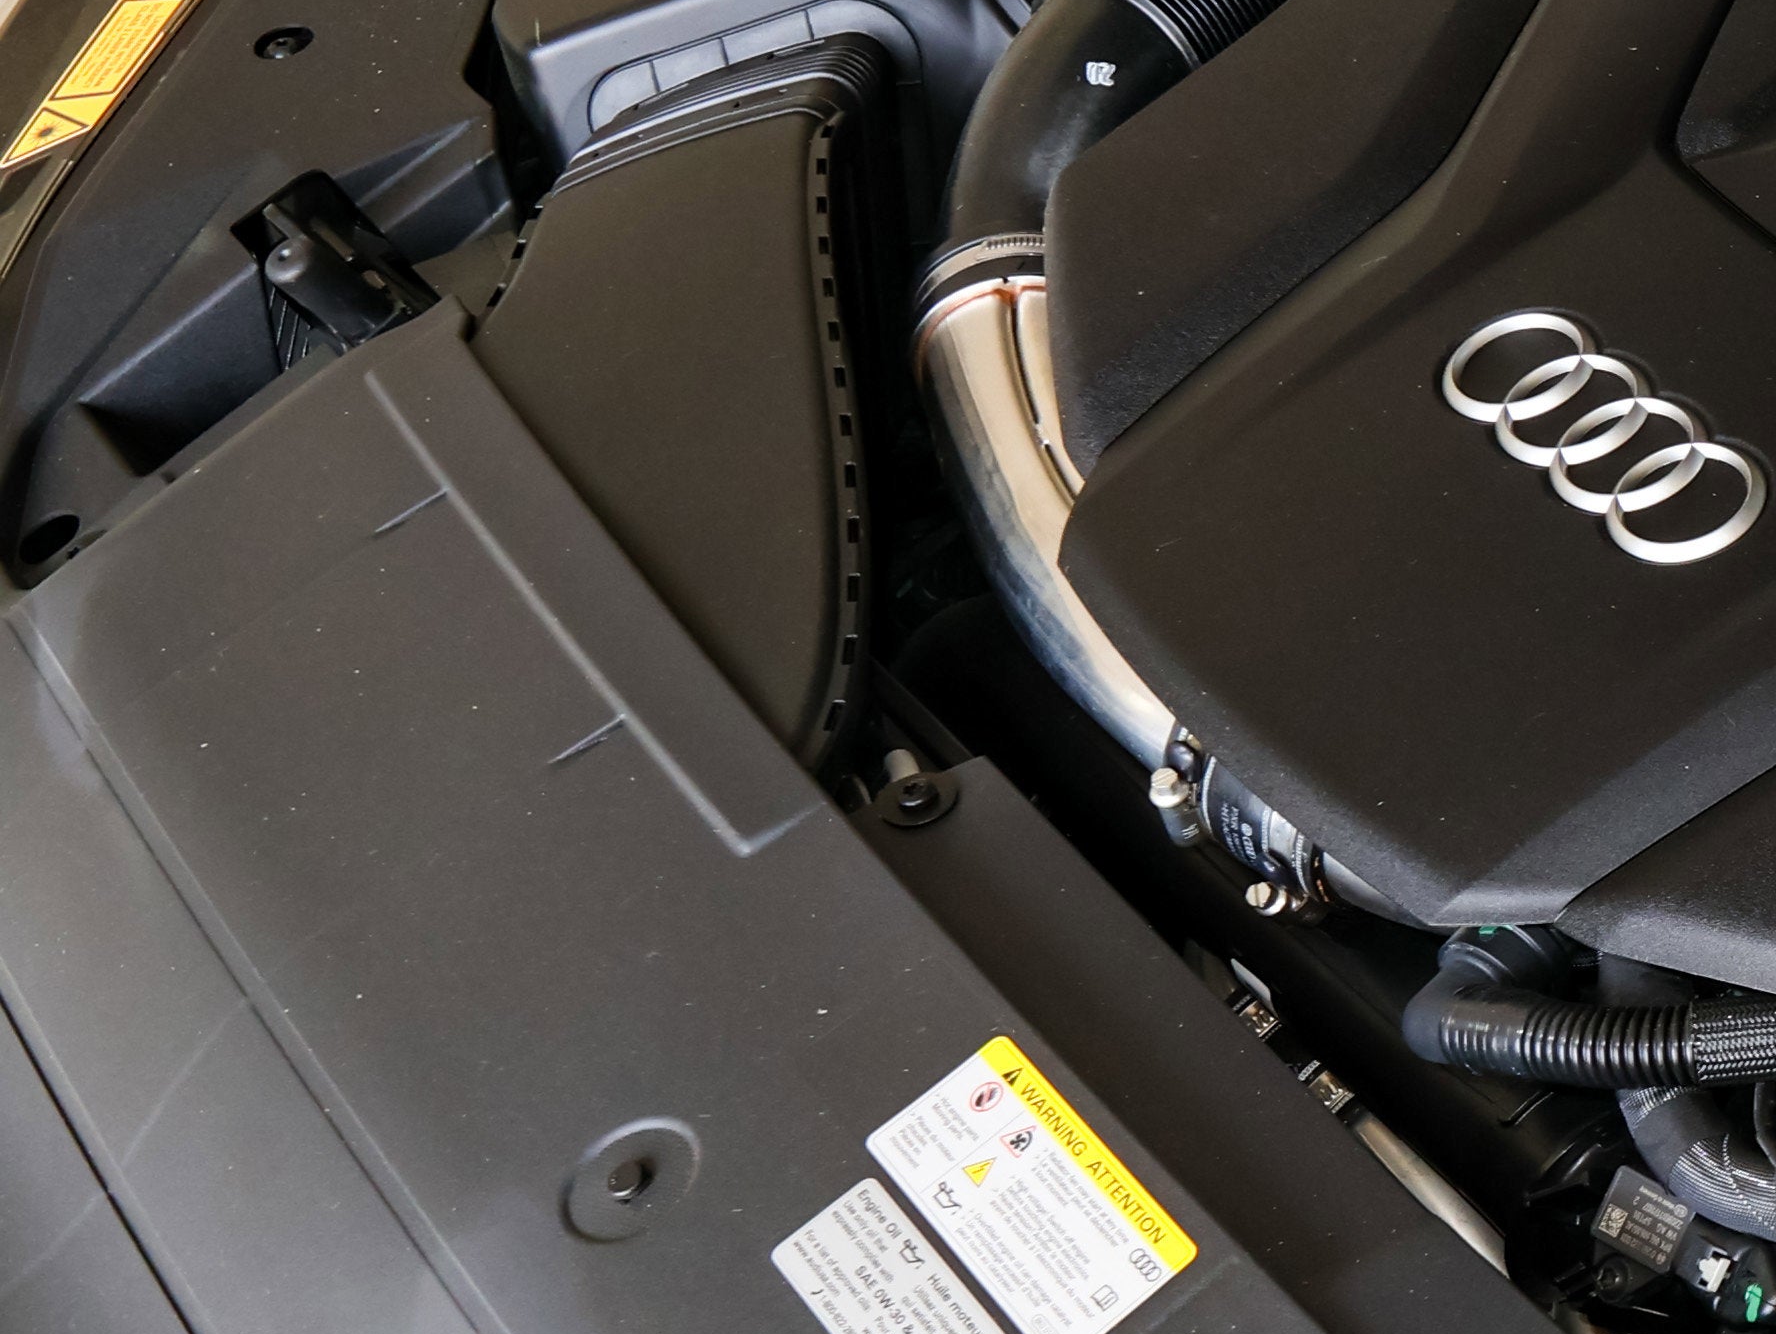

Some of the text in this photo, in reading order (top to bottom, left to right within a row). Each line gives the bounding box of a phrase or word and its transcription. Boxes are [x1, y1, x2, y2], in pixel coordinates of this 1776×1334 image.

[1017, 1082, 1168, 1245] WARNING ATTENTION
[853, 1188, 903, 1240] Engine Oil
[853, 1264, 878, 1290] SAE
[871, 1286, 907, 1326] 0W-30
[925, 1271, 956, 1303] Huile
